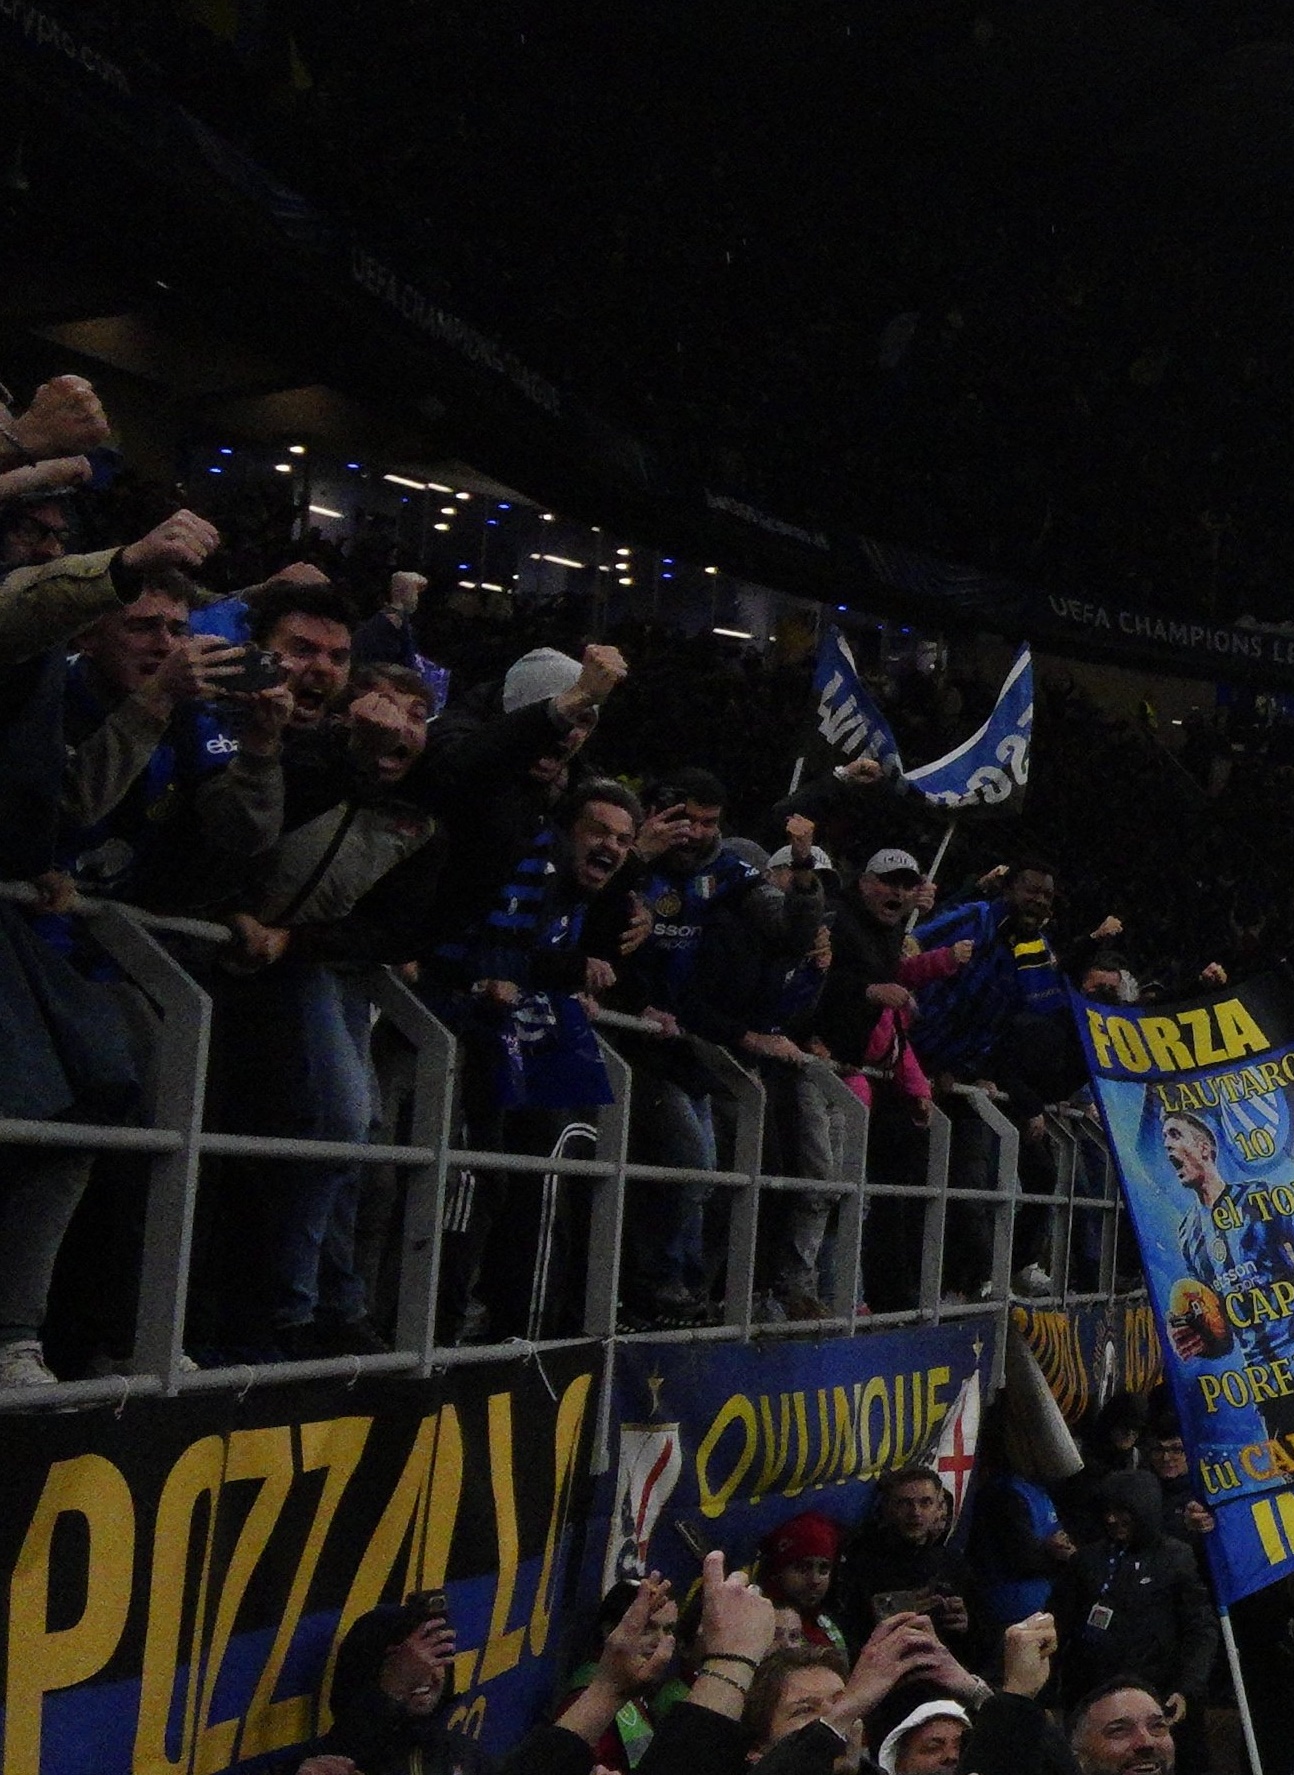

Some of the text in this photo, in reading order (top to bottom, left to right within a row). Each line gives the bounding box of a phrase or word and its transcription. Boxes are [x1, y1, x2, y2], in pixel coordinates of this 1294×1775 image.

[1049, 595, 1111, 629] UEFA
[1118, 610, 1262, 658] CHAMPIONS
[1086, 998, 1271, 1074] FORZA
[1235, 1128, 1275, 1162] 10
[1212, 1195, 1244, 1230] el
